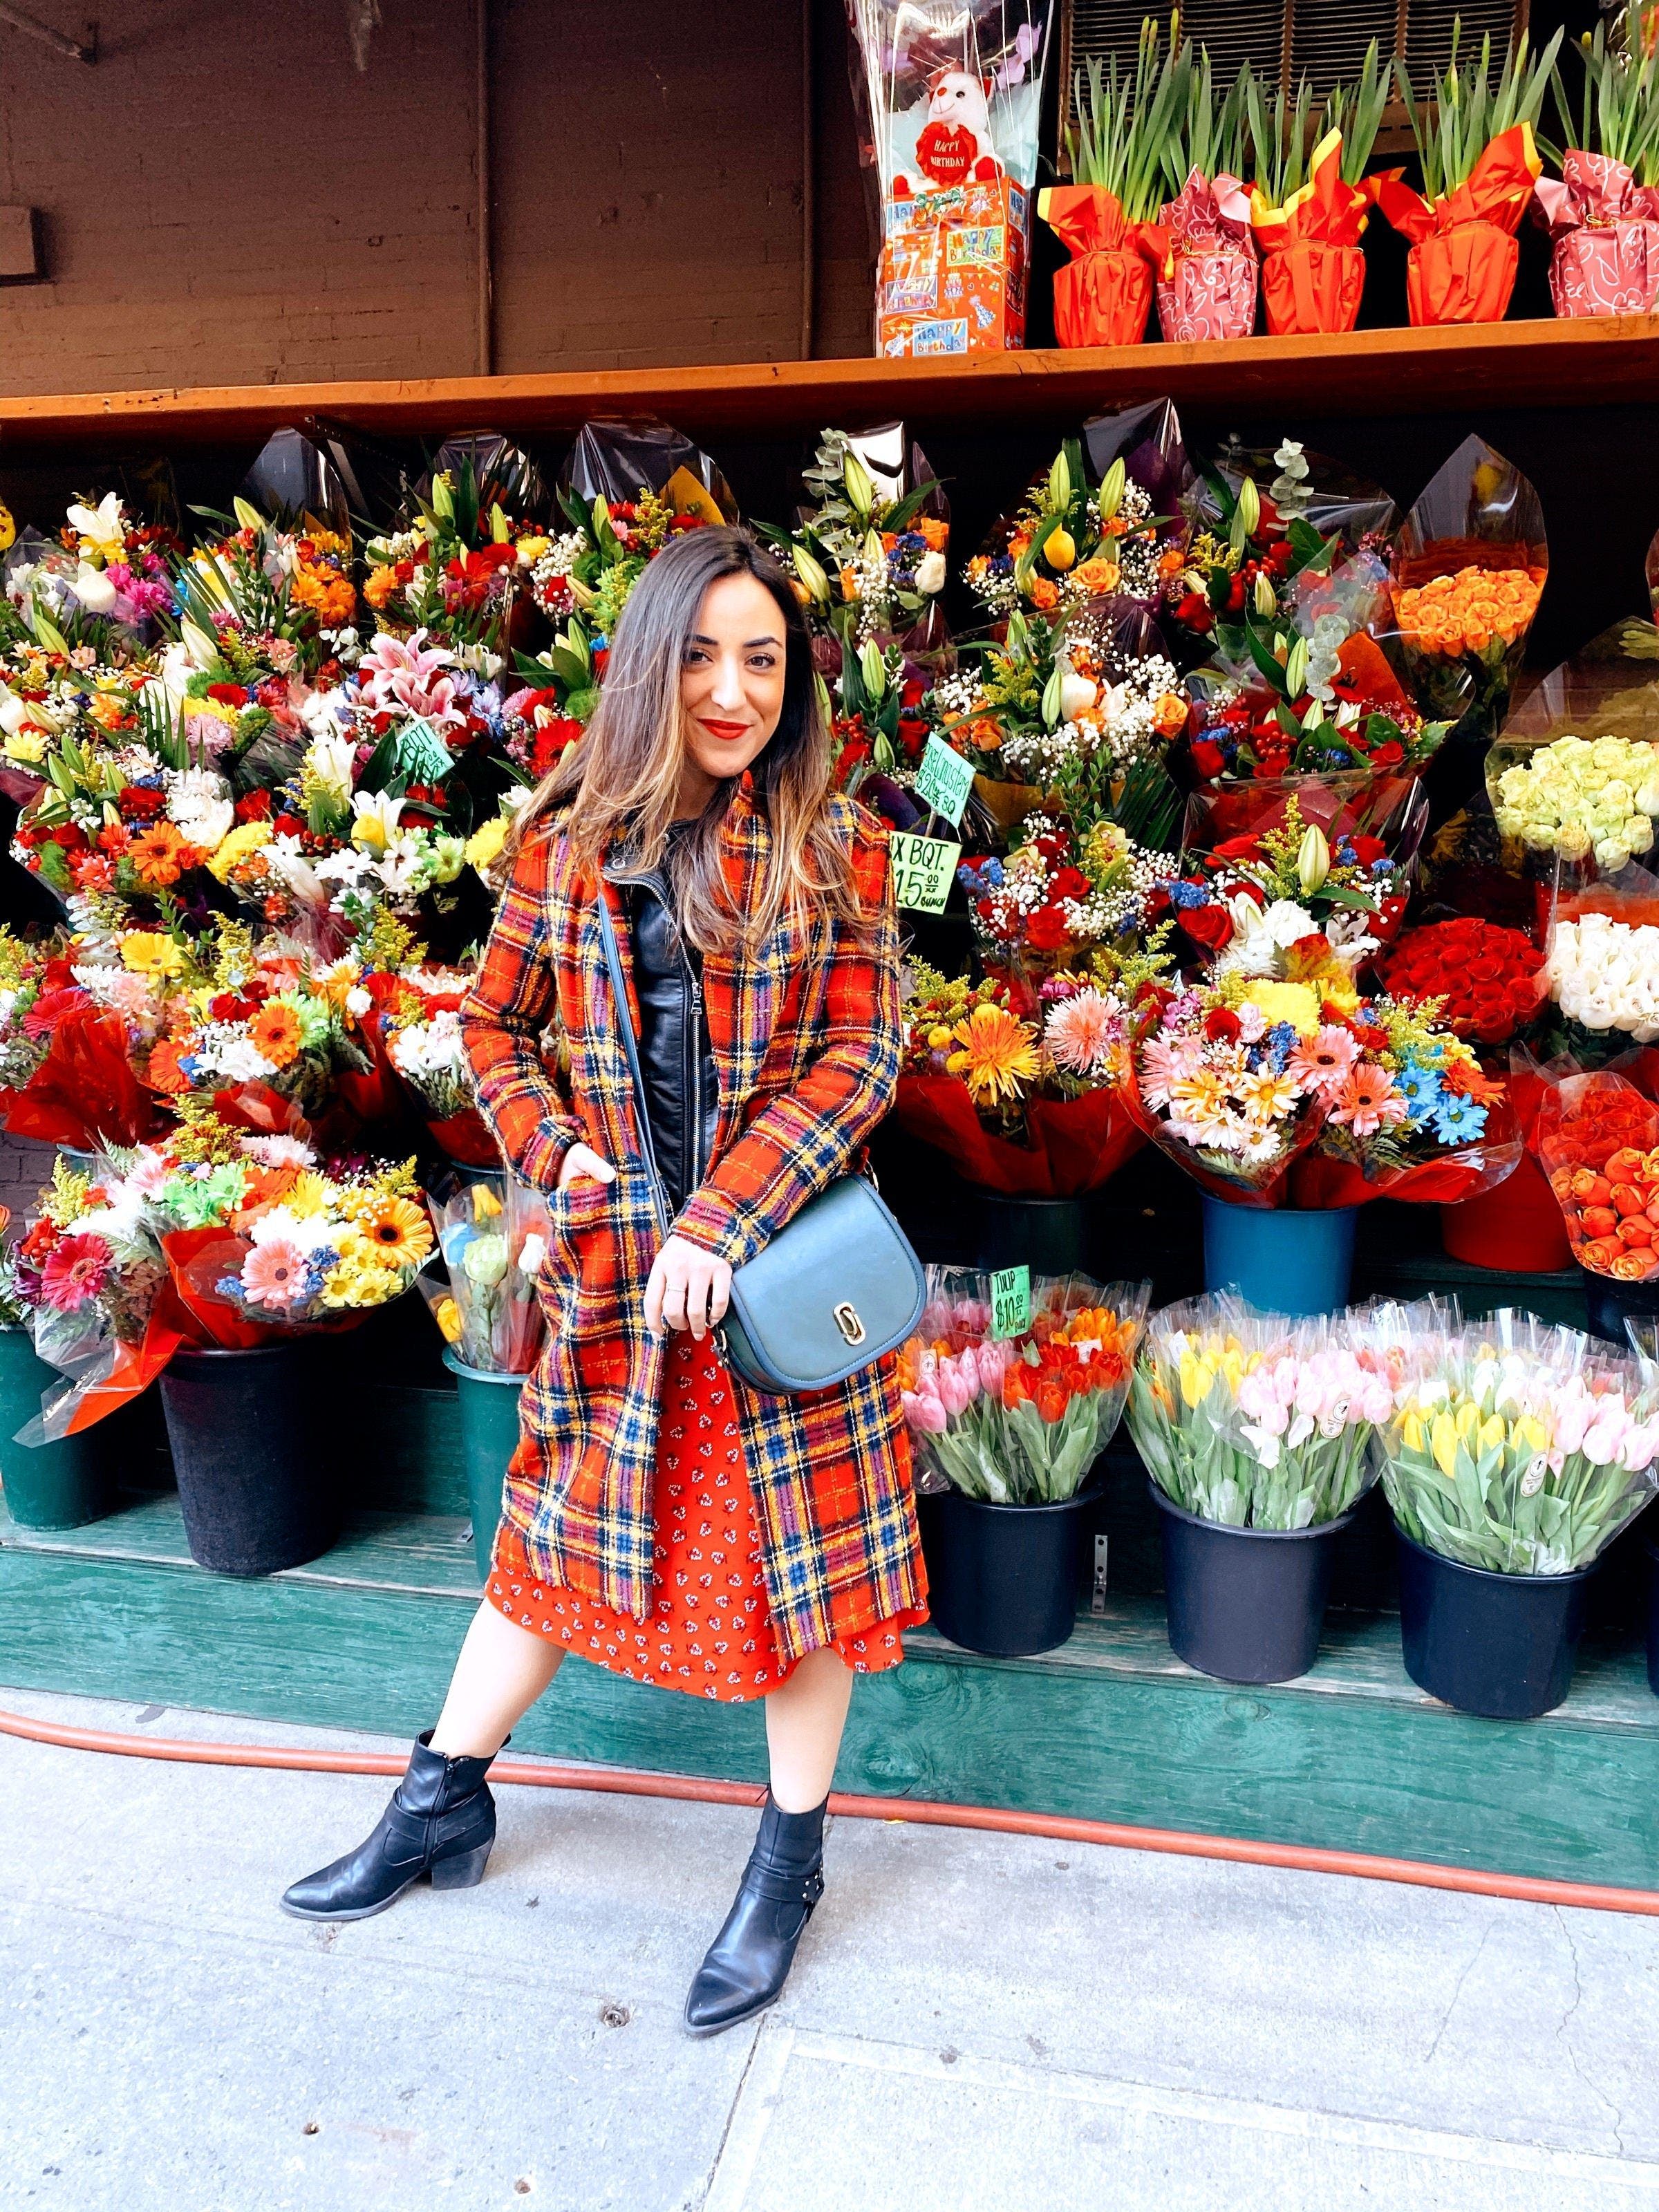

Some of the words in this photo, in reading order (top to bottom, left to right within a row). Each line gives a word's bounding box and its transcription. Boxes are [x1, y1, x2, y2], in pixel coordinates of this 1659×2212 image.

[933, 139, 960, 152] HAPPY
[930, 156, 965, 167] BIRTHDAY
[917, 336, 964, 353] Birthday
[920, 897, 946, 908] BUNCH
[993, 1271, 1015, 1295] TULIP
